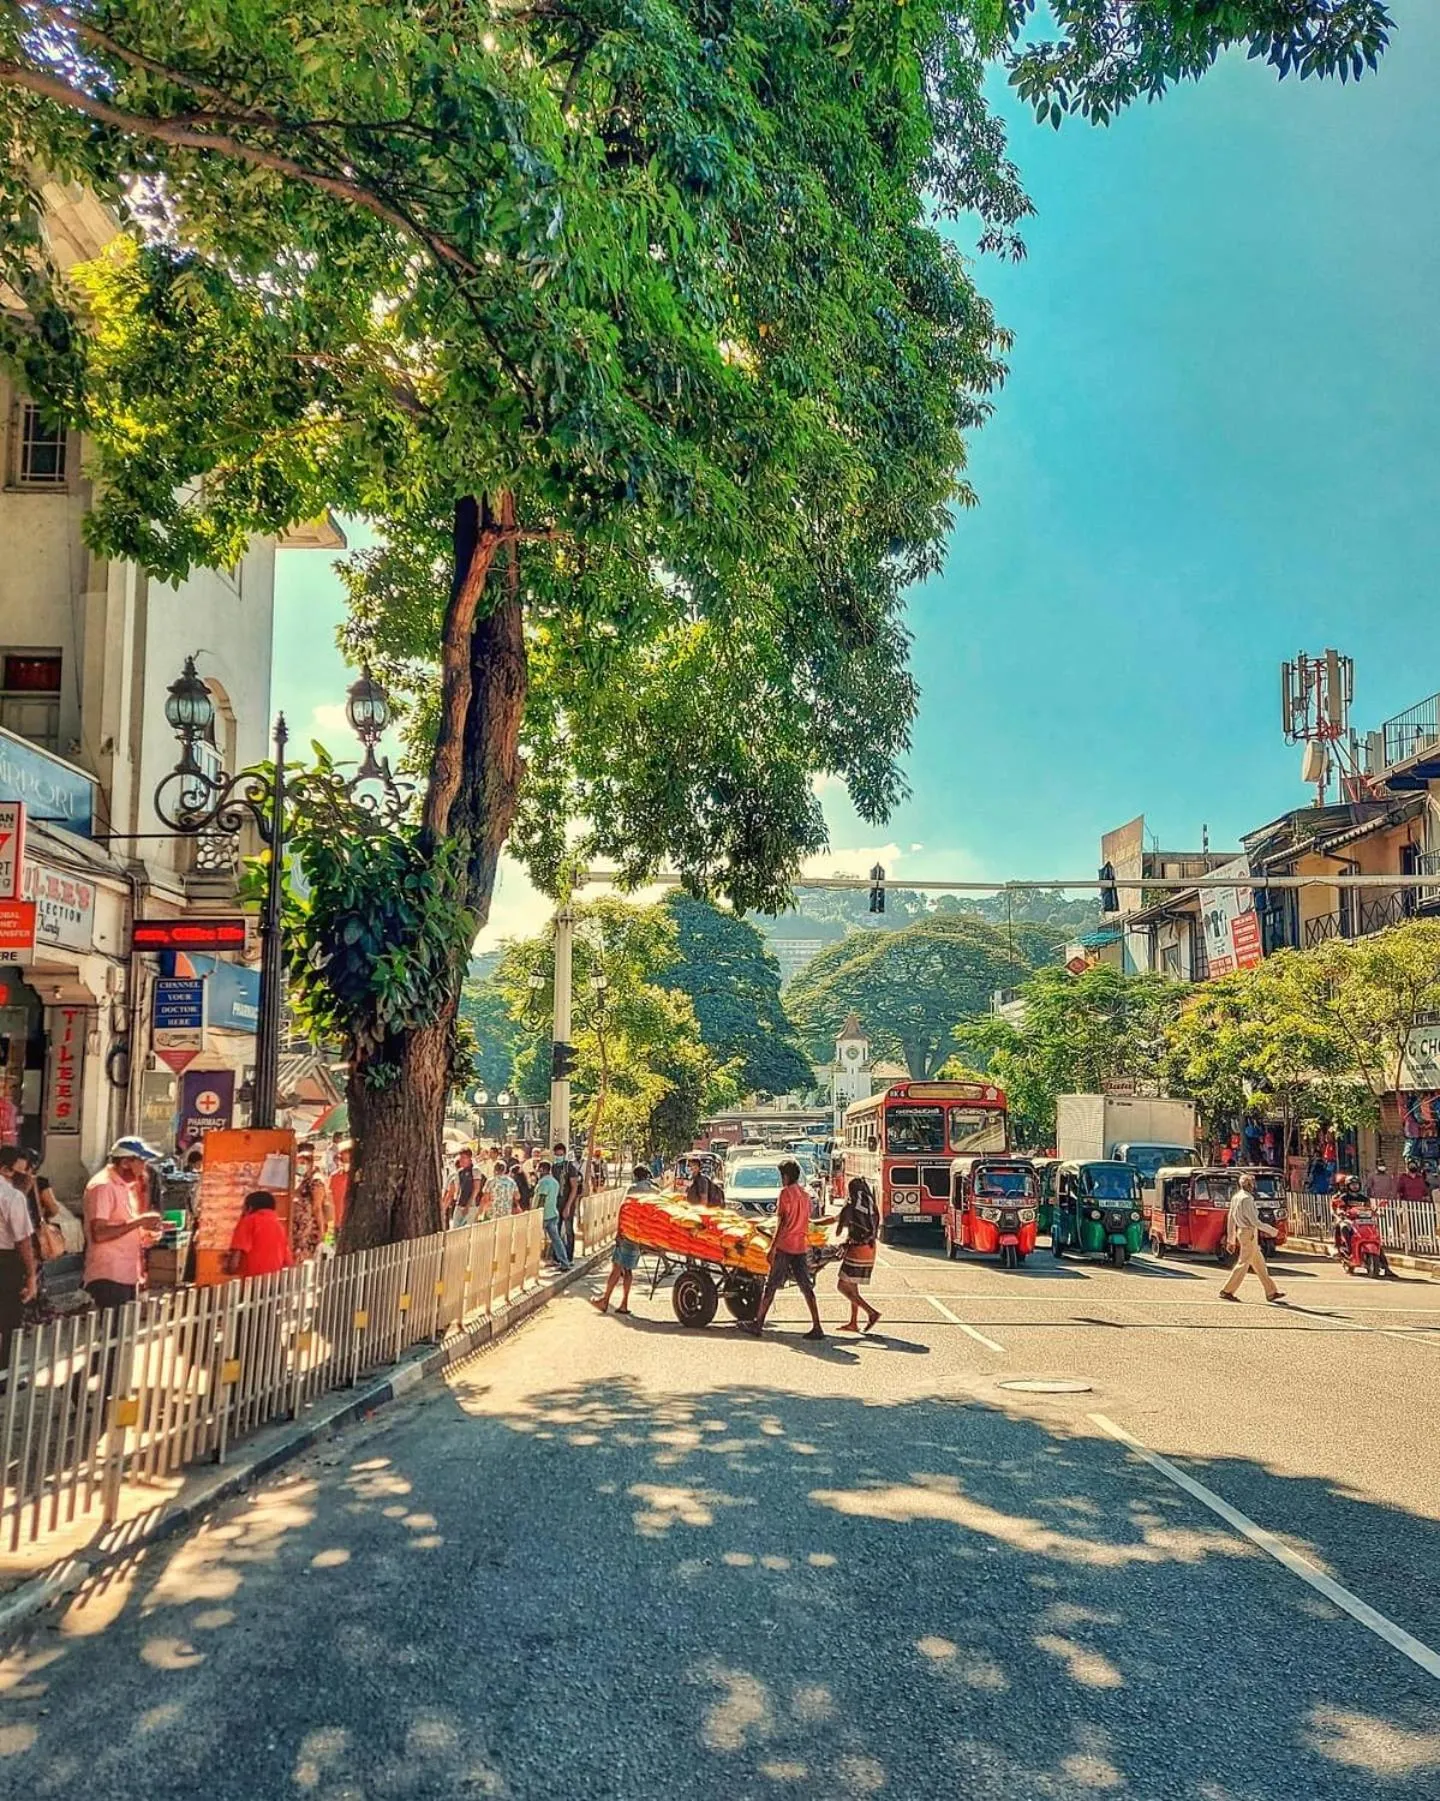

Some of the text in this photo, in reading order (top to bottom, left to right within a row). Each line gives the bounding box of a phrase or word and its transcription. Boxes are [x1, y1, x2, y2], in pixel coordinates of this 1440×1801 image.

[159, 981, 200, 989] CHANNEL
[167, 993, 192, 1001] YOUR
[161, 1006, 197, 1014] DOCTOR
[167, 1018, 191, 1026] HERE
[55, 1008, 79, 1118] TILEES
[187, 1118, 227, 1127] PHARMACY
